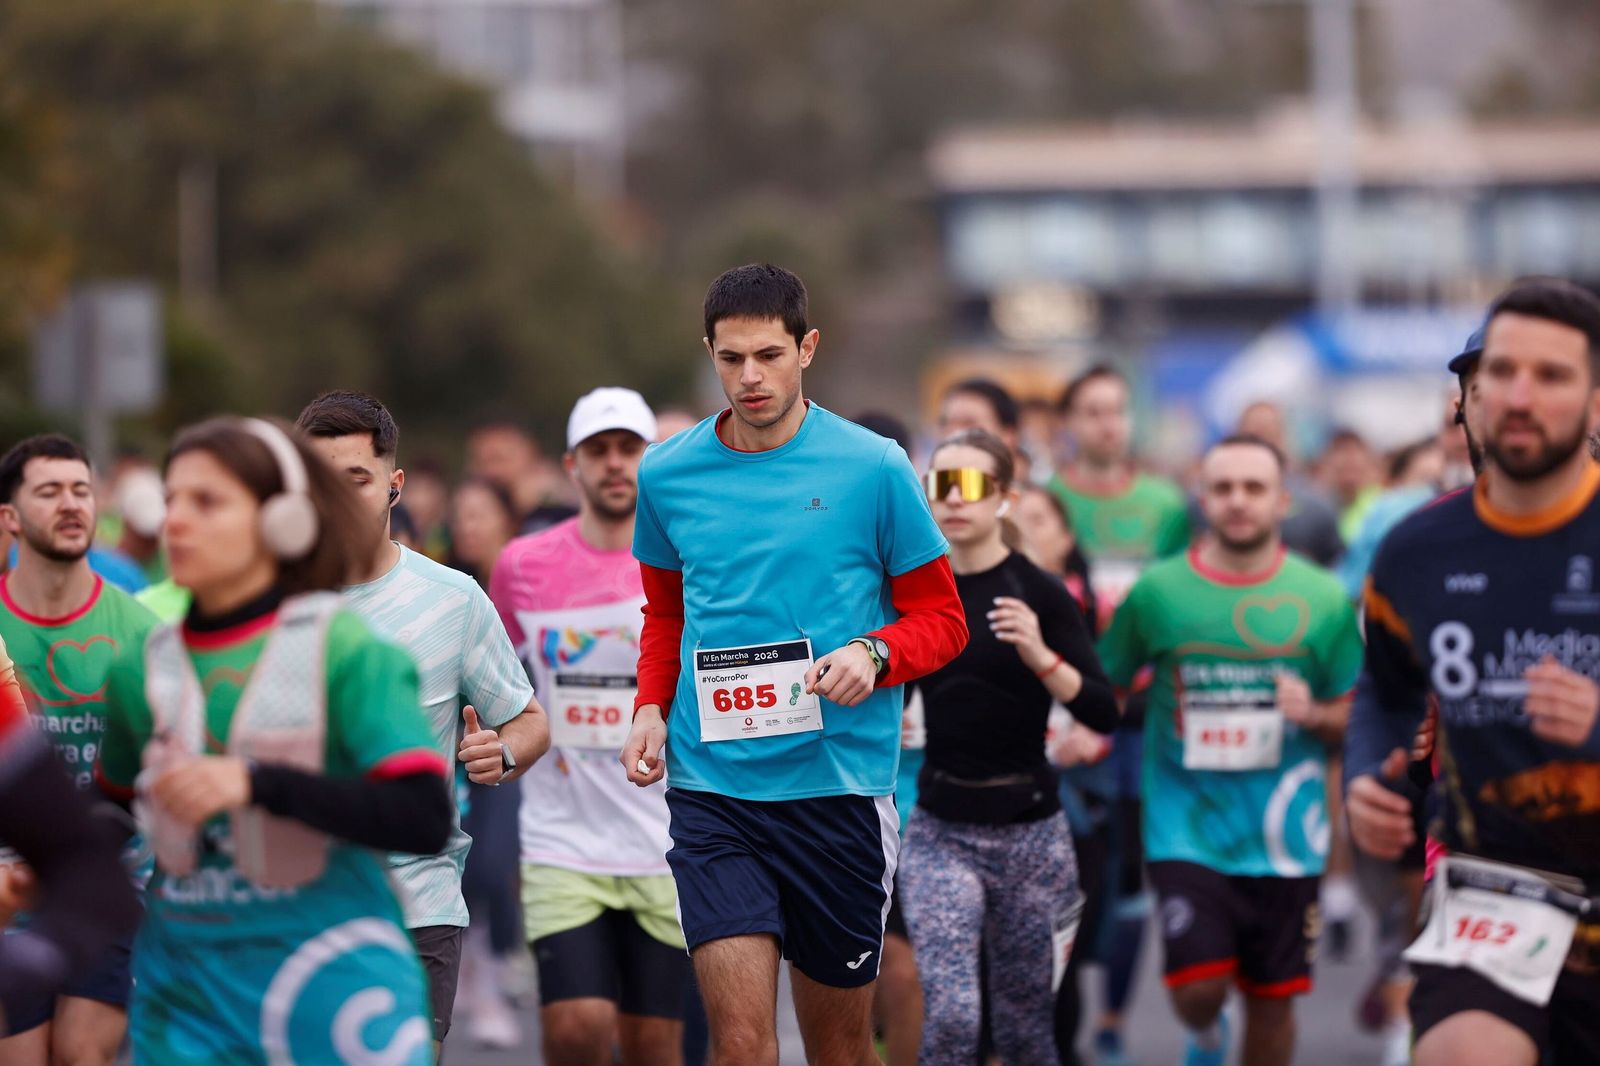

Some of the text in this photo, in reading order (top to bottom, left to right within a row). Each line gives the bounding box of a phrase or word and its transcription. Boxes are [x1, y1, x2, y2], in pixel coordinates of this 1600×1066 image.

[703, 650, 779, 663] IV En Marcha 2026
[1430, 621, 1478, 700] 8
[702, 673, 749, 683] #YoCorroPor
[713, 683, 777, 713] 685
[565, 704, 622, 726] 620
[1455, 915, 1518, 945] 162
